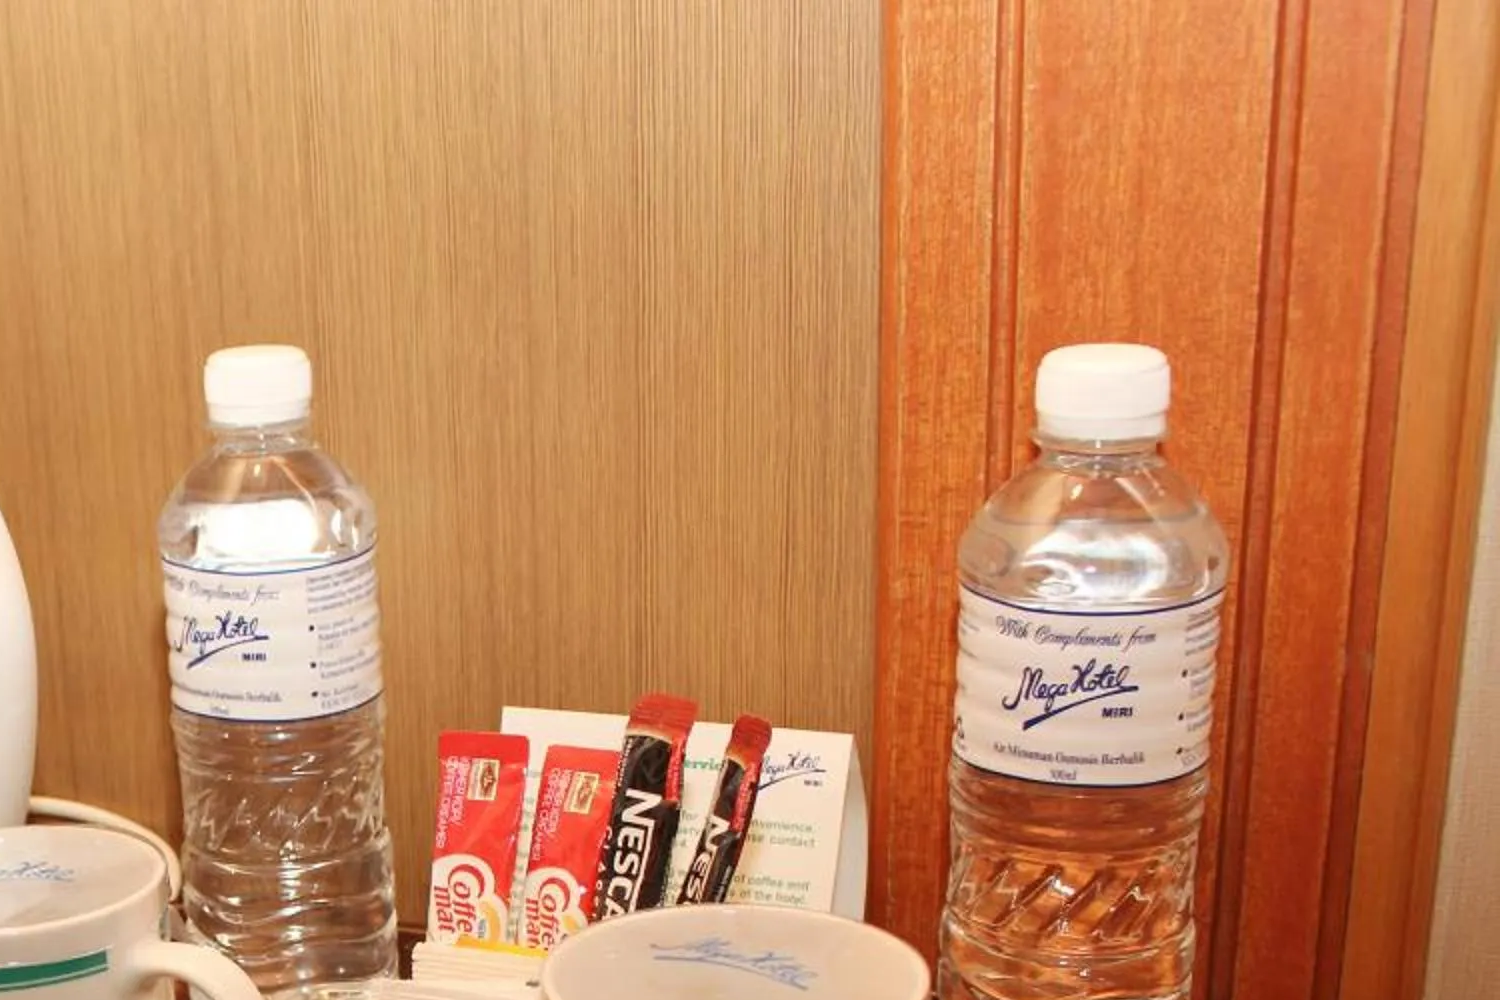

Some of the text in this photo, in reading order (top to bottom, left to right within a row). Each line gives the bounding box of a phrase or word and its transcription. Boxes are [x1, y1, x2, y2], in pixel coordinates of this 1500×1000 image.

[1035, 626, 1123, 651] Compliments
[1002, 657, 1131, 713] Mega Hotel
[1101, 706, 1133, 719] MIRI
[602, 787, 663, 920] NESCA
